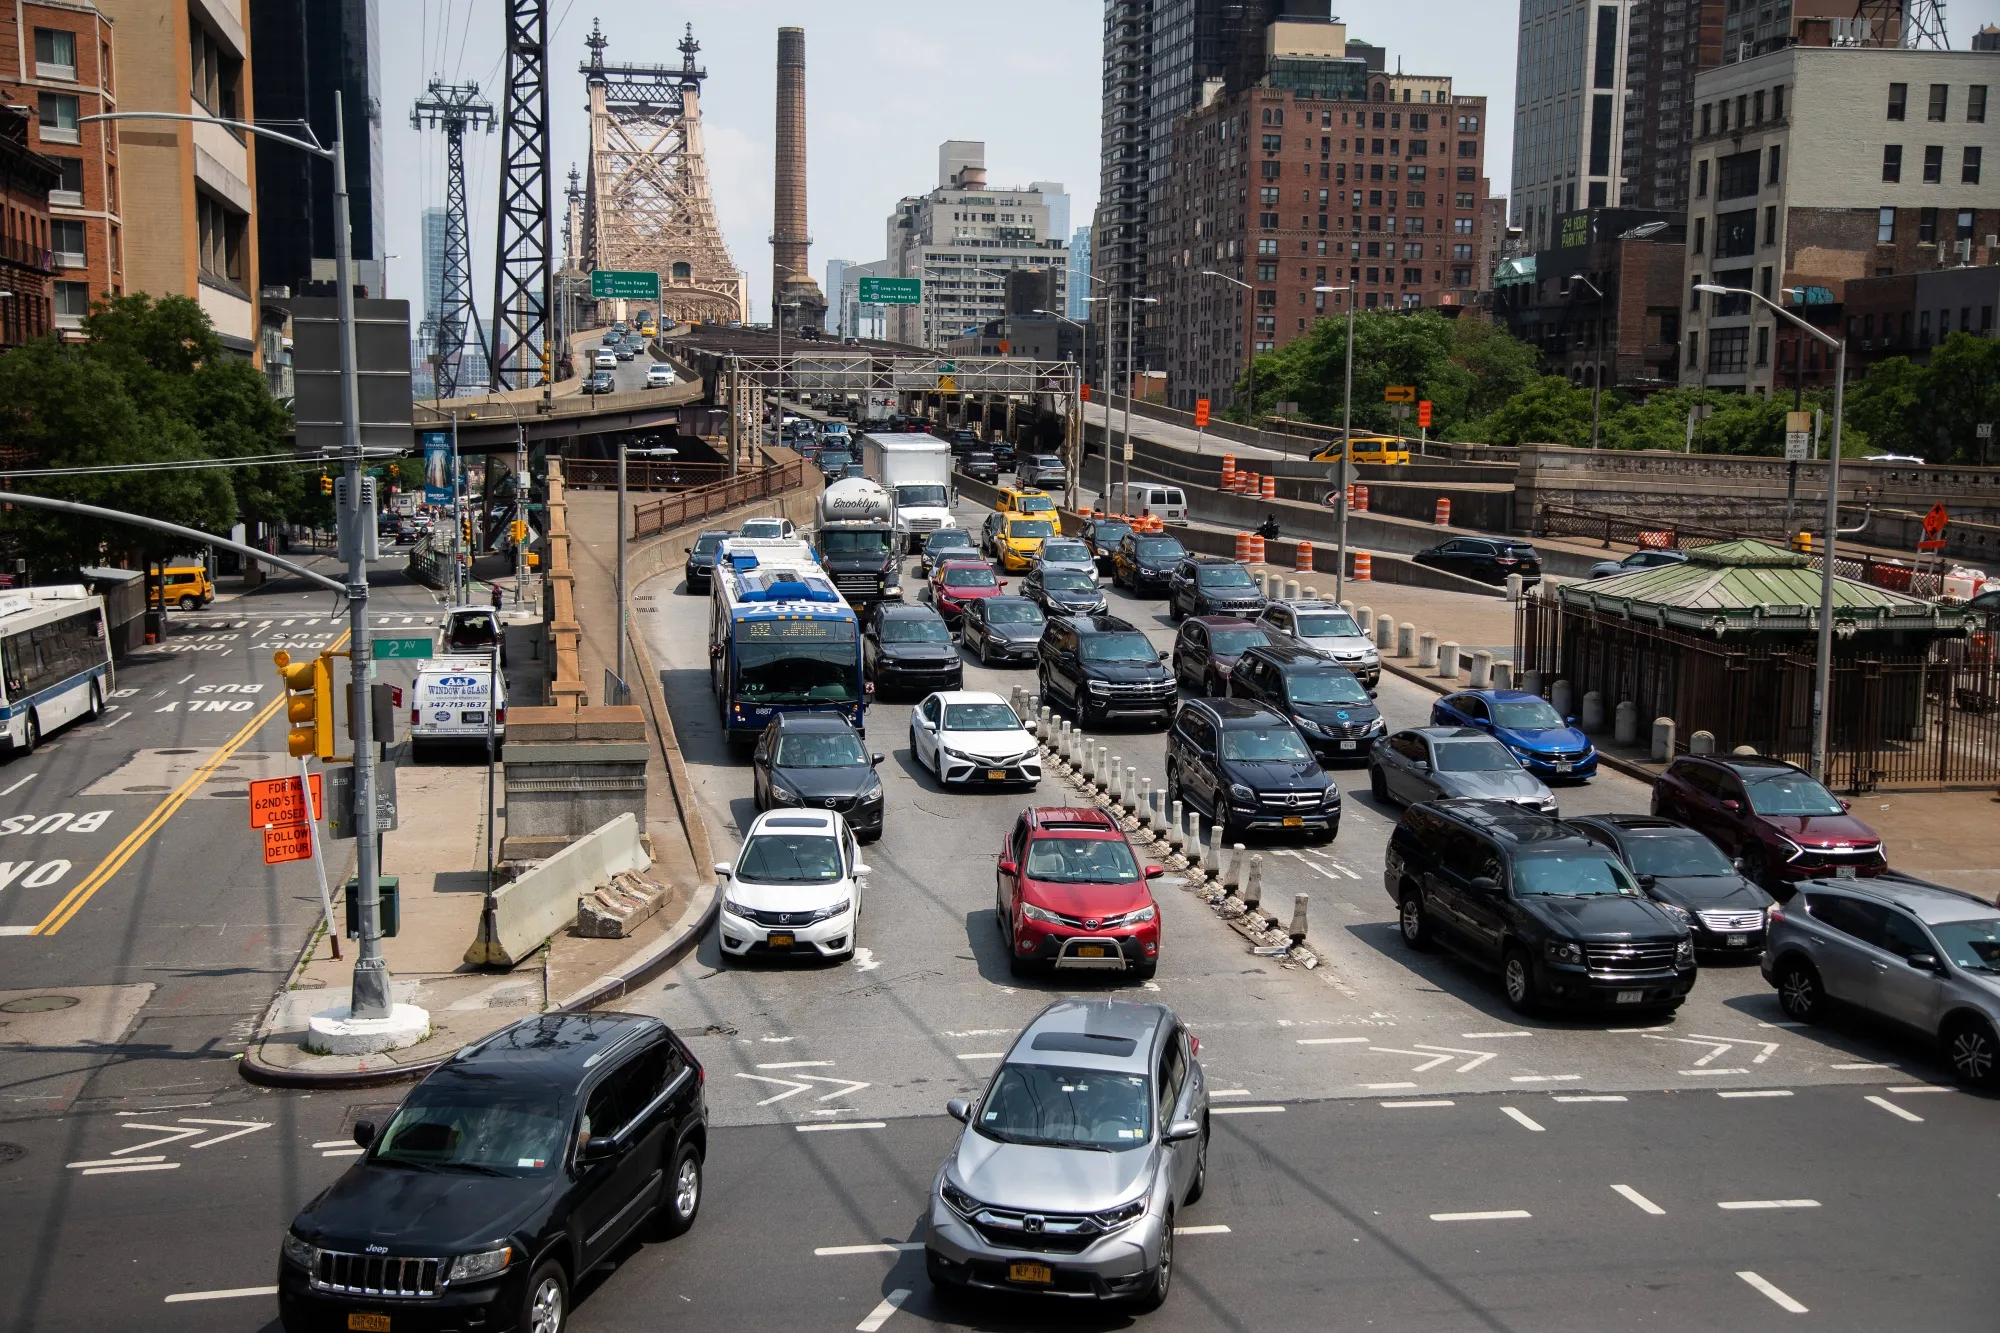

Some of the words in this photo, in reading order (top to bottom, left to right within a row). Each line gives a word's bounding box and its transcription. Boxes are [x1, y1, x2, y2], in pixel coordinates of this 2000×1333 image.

[1562, 218, 1571, 232] 24
[1574, 215, 1587, 230] HOUR
[1562, 230, 1586, 248] PARKING
[871, 398, 896, 406] FedEx
[834, 498, 880, 513] Brooklyn
[389, 641, 399, 656] 2
[193, 684, 264, 694] BUS
[428, 686, 460, 694] WINDOW
[466, 685, 488, 694] GLASS
[154, 701, 255, 713] ONLY
[269, 782, 287, 793] FDR
[255, 798, 280, 809] 62ND
[285, 795, 295, 806] ST
[300, 793, 317, 804] ET
[268, 809, 305, 821] CLOSED
[0, 810, 114, 835] BUS
[267, 829, 308, 843] FOLLOW
[268, 843, 308, 857] DETOUR
[366, 1244, 388, 1254] Jeep
